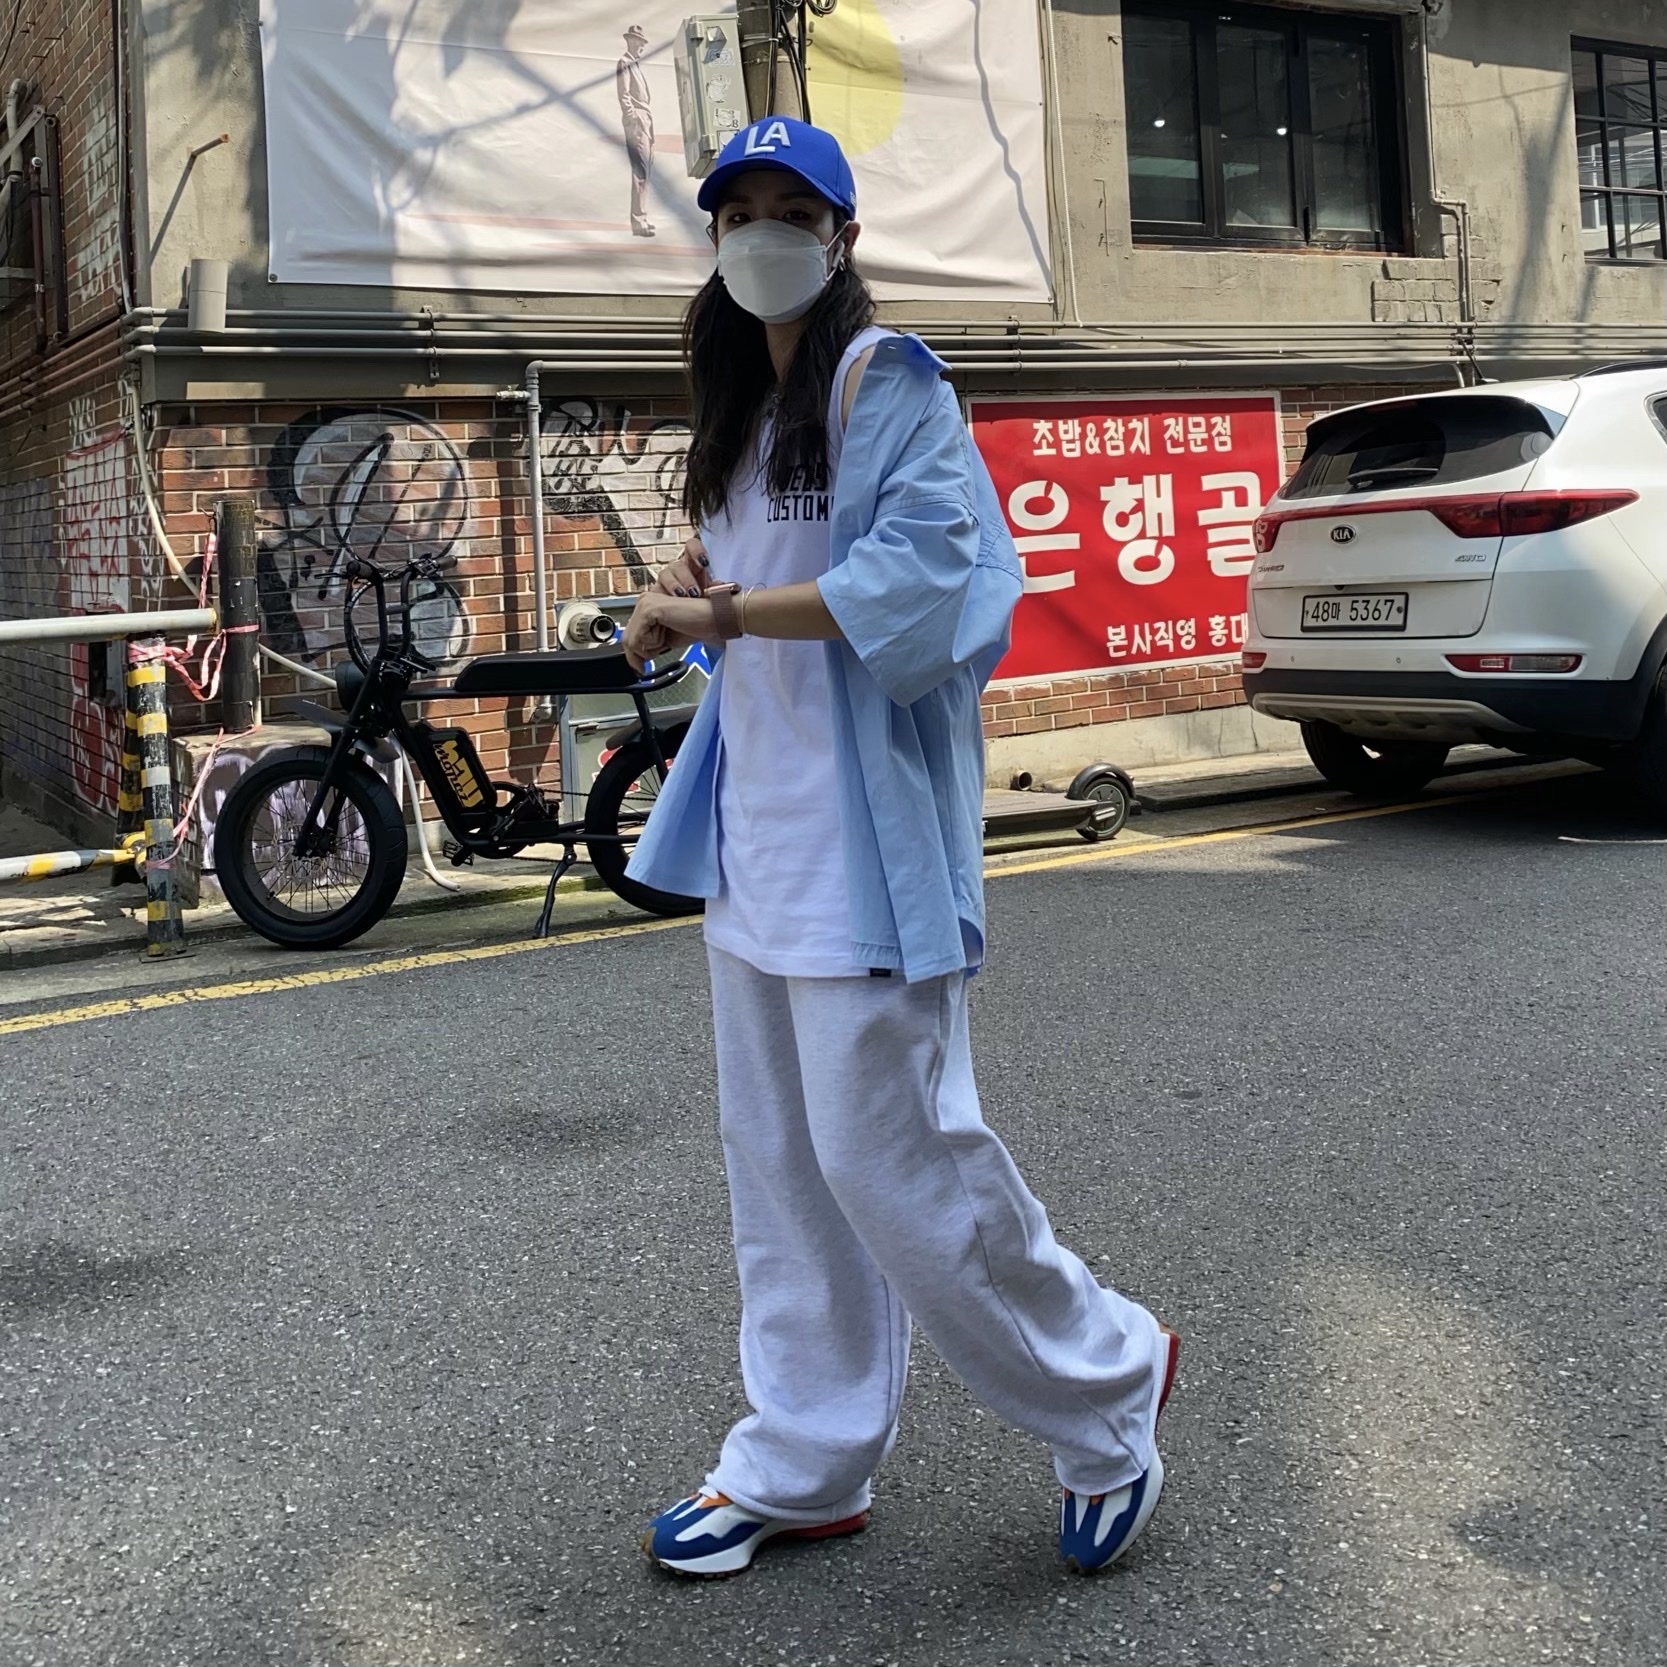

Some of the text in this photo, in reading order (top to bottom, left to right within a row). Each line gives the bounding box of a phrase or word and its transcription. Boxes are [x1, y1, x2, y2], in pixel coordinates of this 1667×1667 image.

[744, 121, 791, 156] LA
[1033, 415, 1233, 458] 초밥&참치 전문점
[767, 495, 835, 523] CUSTOM
[1008, 471, 1268, 594] 은행골
[1333, 528, 1351, 540] KIA
[1311, 599, 1395, 622] 48마 5367
[1106, 612, 1249, 658] 본사직영 홍대
